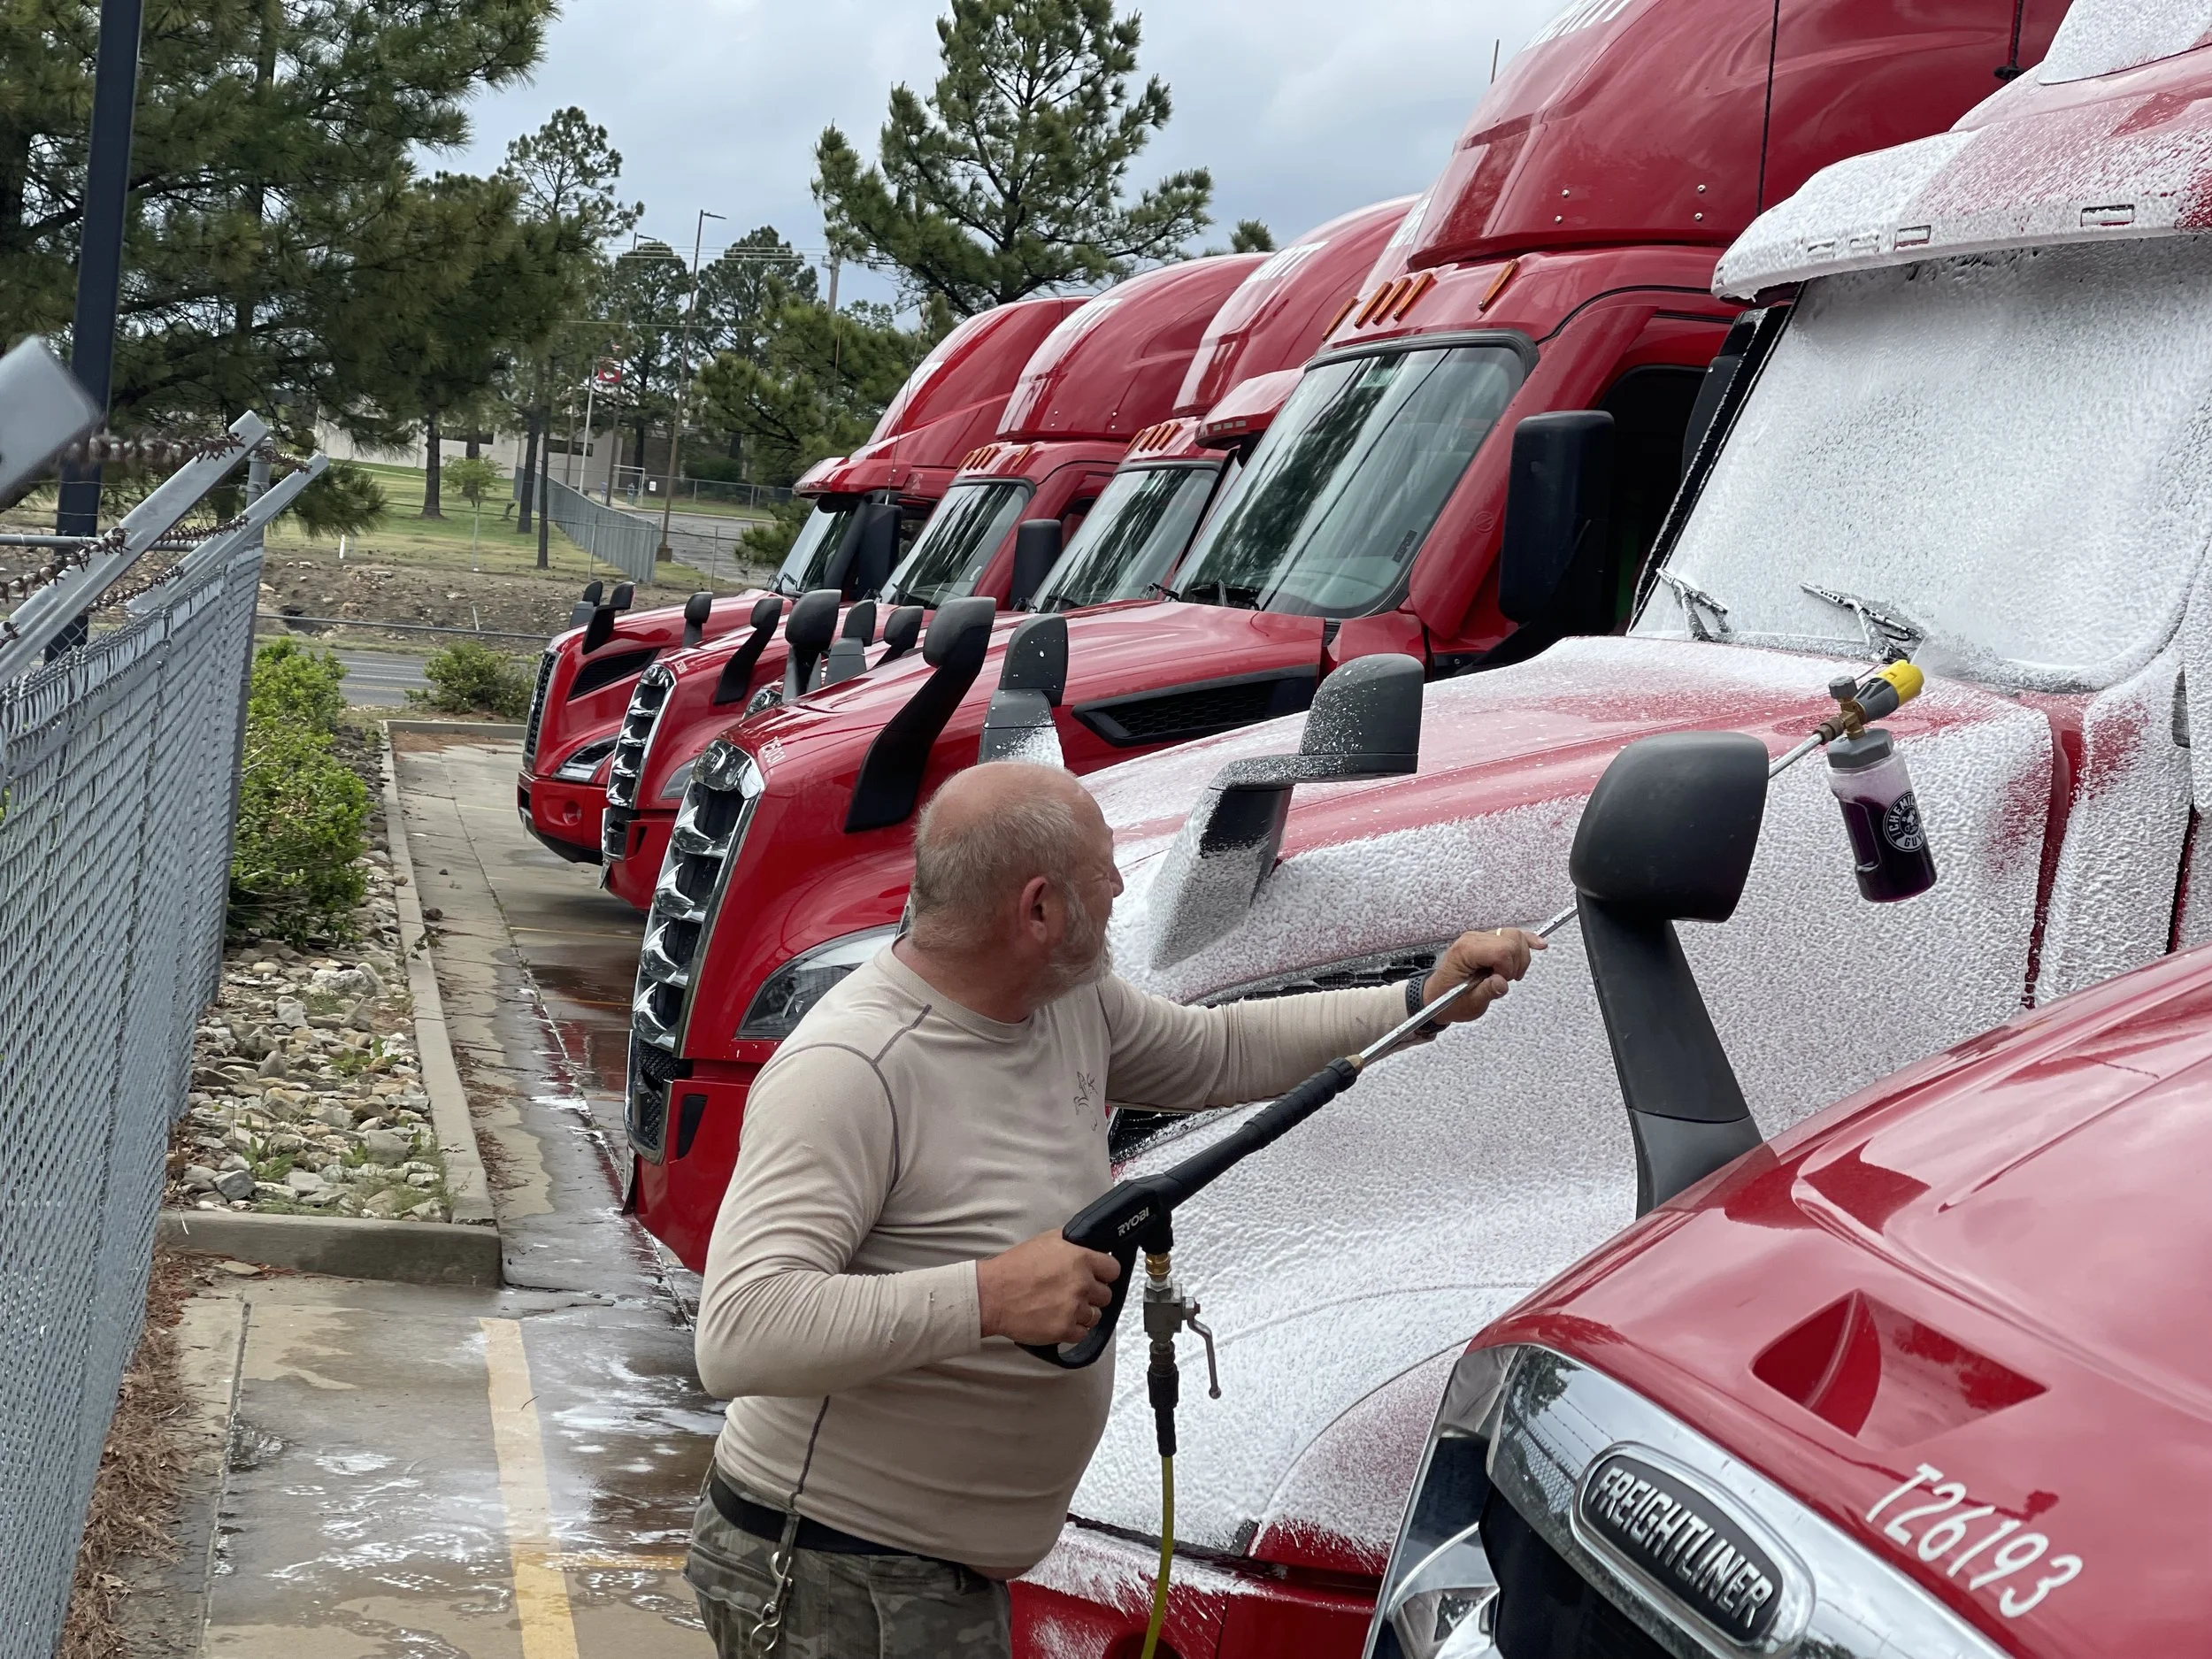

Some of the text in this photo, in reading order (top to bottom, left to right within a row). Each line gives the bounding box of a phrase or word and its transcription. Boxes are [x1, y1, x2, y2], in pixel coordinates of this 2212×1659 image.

[1117, 1206, 1150, 1237] RYOBI
[1590, 1466, 1775, 1629] FREIGHTLINER
[1866, 1462, 2083, 1618] T26193
